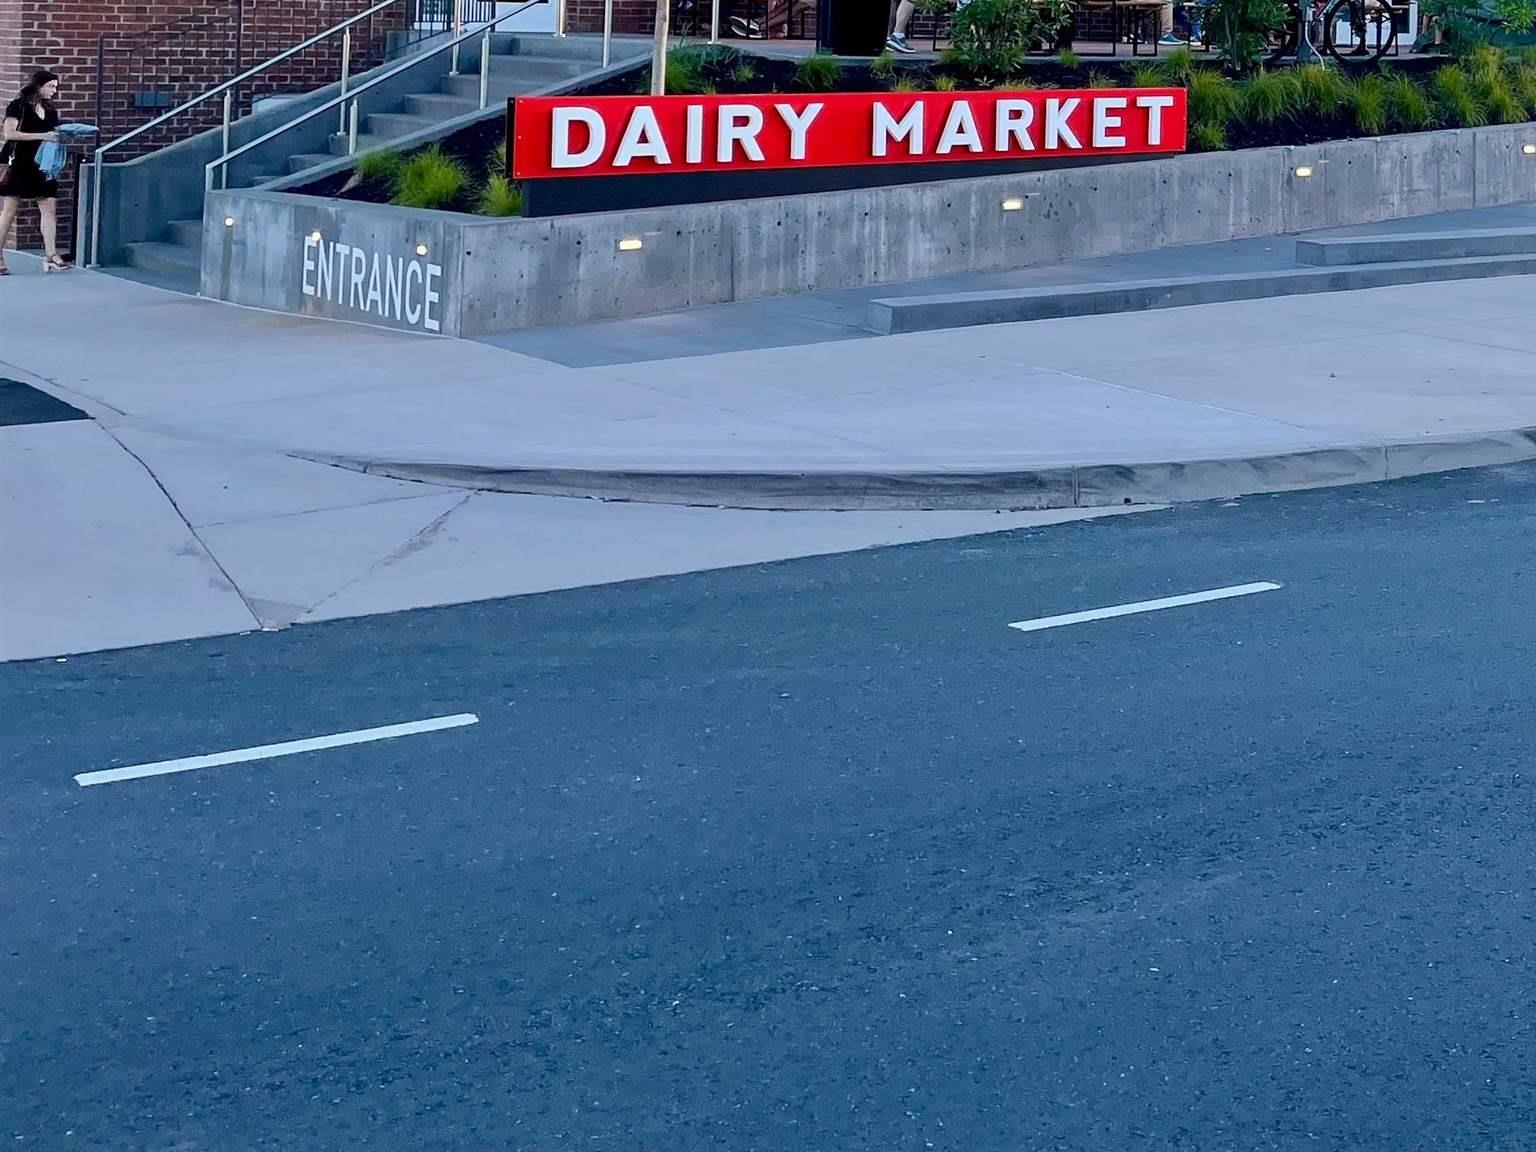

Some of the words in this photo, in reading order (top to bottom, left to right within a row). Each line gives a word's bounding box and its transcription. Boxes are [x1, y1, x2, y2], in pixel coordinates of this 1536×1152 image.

[550, 102, 825, 169] DAIRY
[871, 95, 1175, 157] MARKET
[302, 235, 442, 331] ENTRANCE
